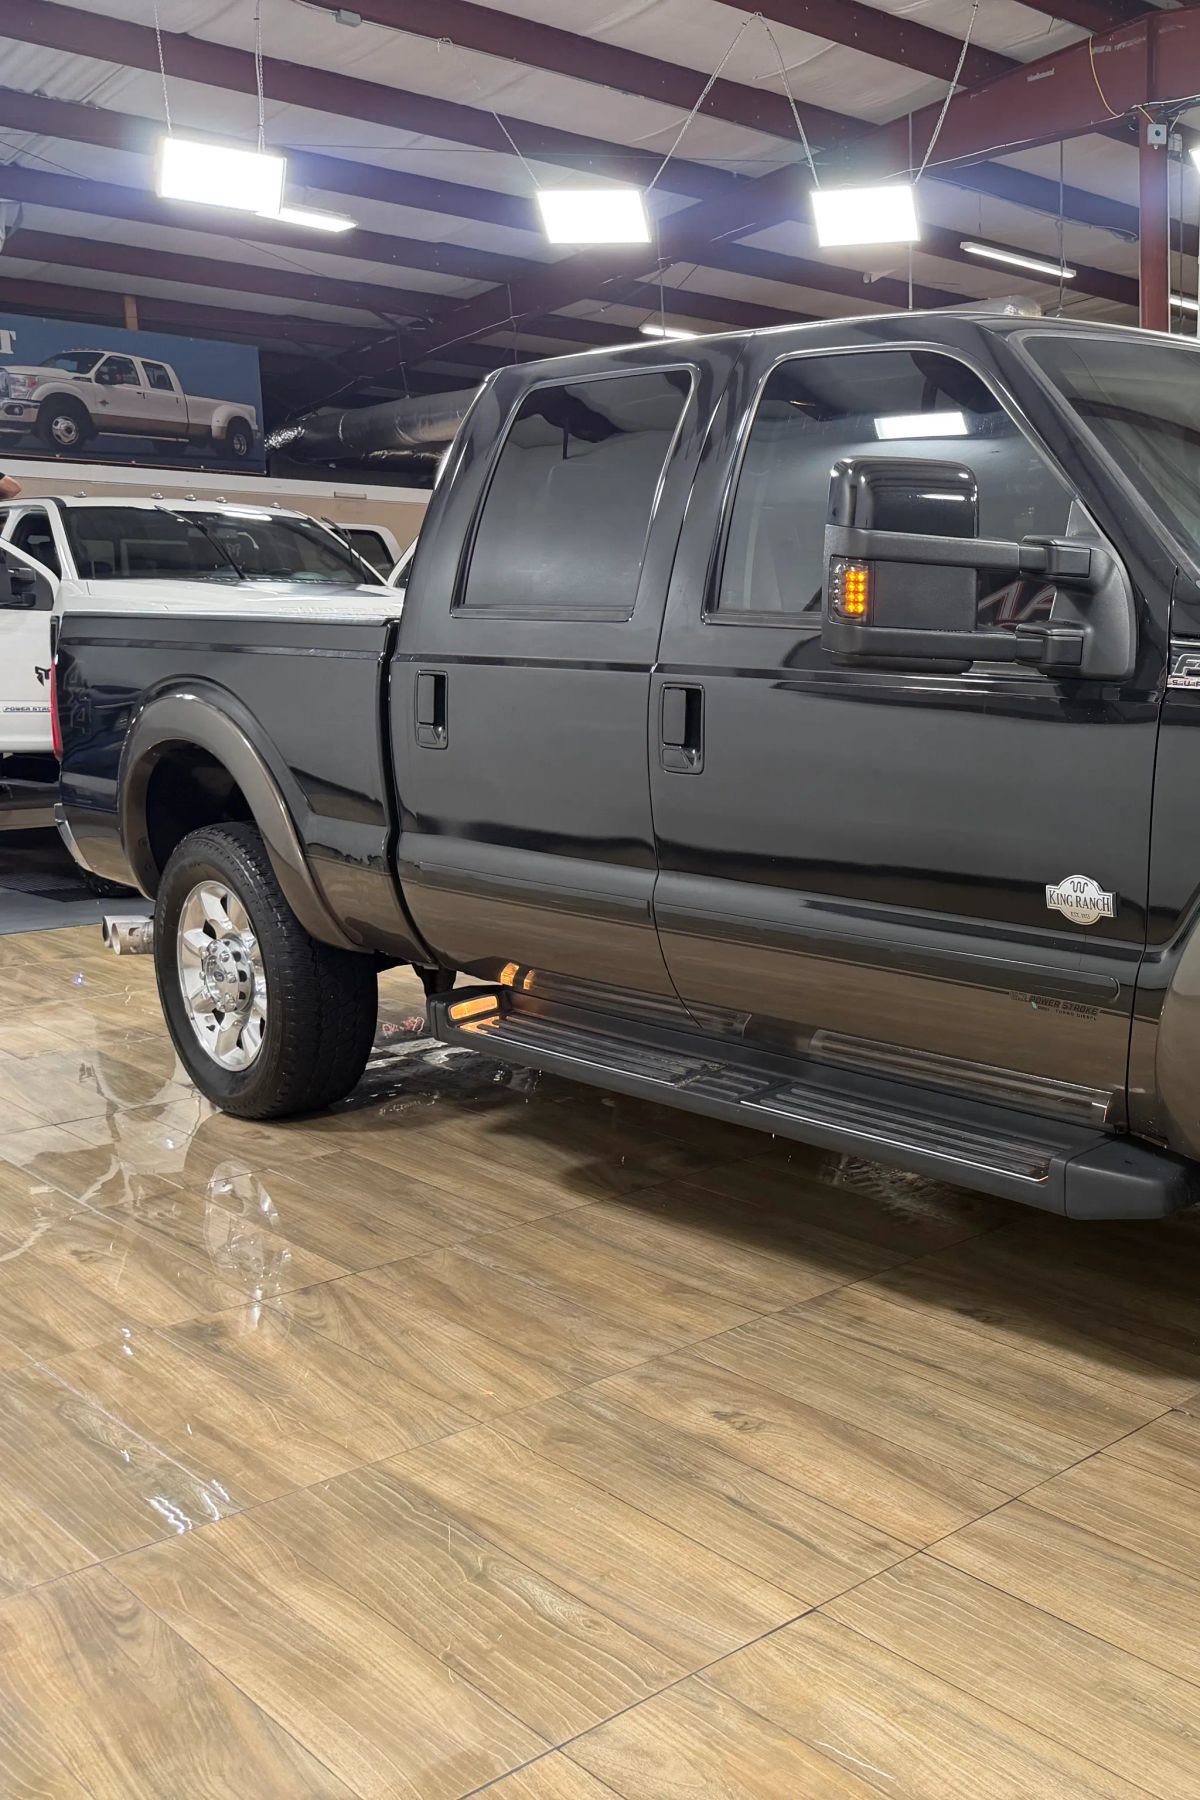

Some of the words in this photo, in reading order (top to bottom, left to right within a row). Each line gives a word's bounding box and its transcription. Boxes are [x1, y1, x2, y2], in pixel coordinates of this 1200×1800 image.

[1048, 889, 1073, 908] KING
[1075, 895, 1110, 913] RANCH
[1028, 995, 1061, 1009] POWER
[1061, 1001, 1099, 1017] STROKE
